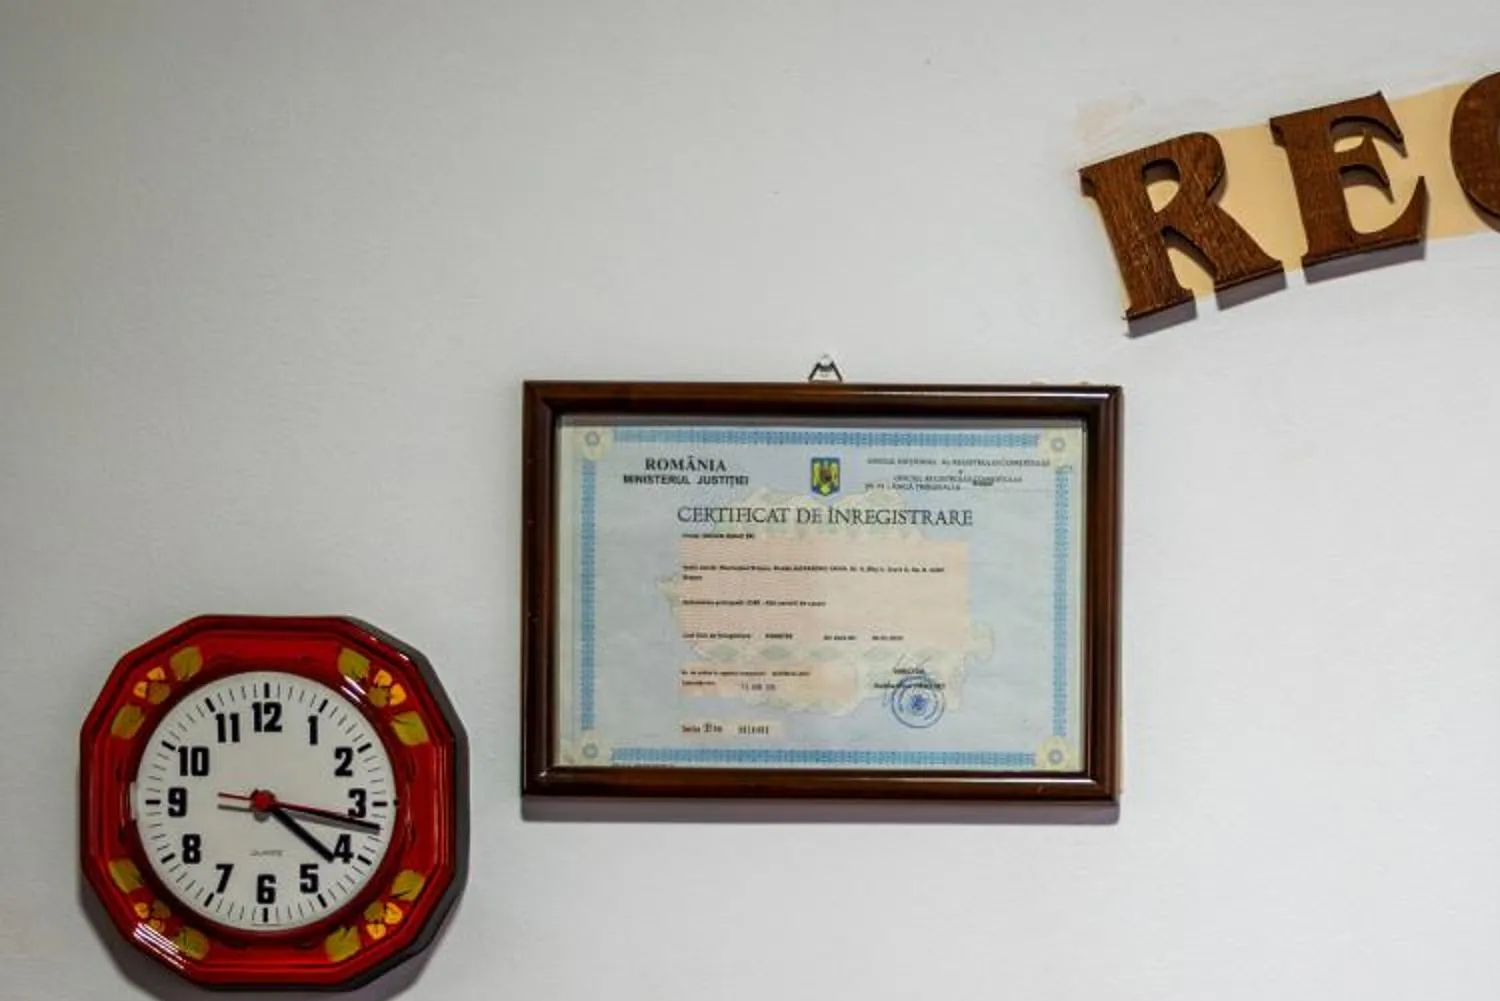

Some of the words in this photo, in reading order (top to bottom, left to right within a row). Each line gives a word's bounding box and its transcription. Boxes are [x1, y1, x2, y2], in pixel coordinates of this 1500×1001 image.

[645, 455, 726, 472] ROMÂNIA
[623, 475, 690, 485] MINISTERUL
[677, 506, 791, 523] CERTIFICAT
[796, 507, 822, 524] DE
[828, 505, 973, 526] ÎNREGISTRARE
[216, 713, 240, 742] 11
[252, 702, 282, 732] 12
[308, 716, 319, 744] 1
[178, 747, 209, 776] 10
[335, 747, 353, 776] 2
[168, 787, 187, 817] 9
[349, 788, 367, 818] 3
[183, 834, 201, 864] 8
[333, 834, 353, 863] 4
[216, 864, 233, 893] 7
[257, 874, 276, 904] 6
[300, 864, 319, 893] 5
